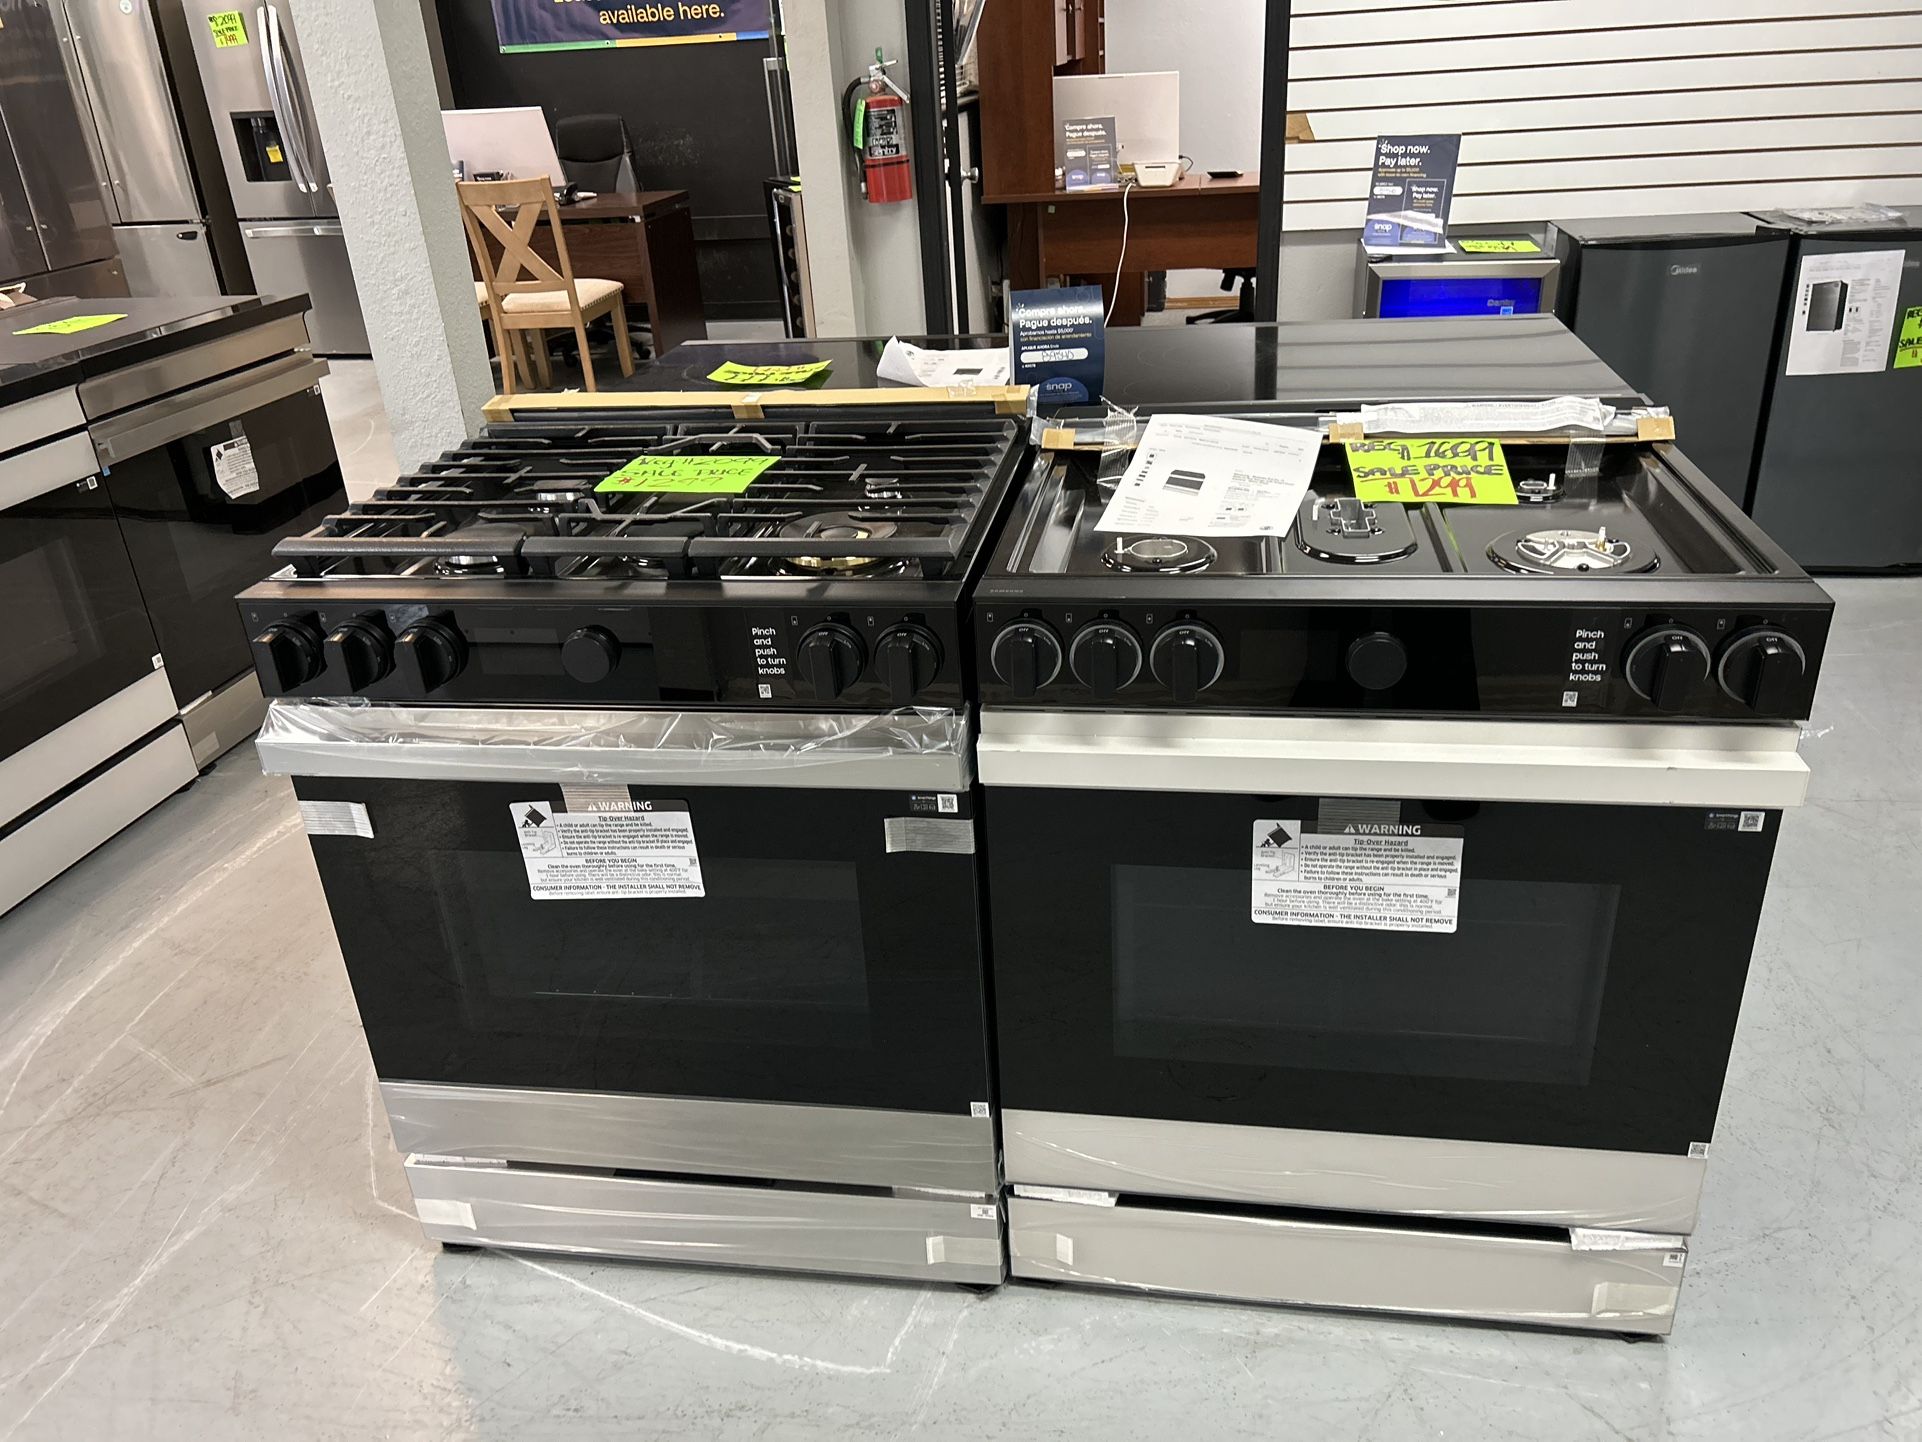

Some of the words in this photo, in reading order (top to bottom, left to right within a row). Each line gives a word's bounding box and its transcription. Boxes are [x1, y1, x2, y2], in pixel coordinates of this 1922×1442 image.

[600, 4, 674, 24] available
[678, 2, 725, 19] here.
[1380, 144, 1406, 154] Shop
[1406, 144, 1430, 154] now.
[1378, 156, 1398, 168] Pay
[1398, 156, 1422, 166] later.
[1018, 307, 1056, 318] Compre
[1020, 319, 1048, 329] Pague
[1050, 316, 1092, 326] después.
[1046, 382, 1072, 392] snap
[1353, 464, 1420, 479] SALE
[1424, 464, 1504, 477] PRICE
[752, 627, 776, 636] Pinch
[1576, 629, 1604, 638] Pinch
[1574, 641, 1596, 649] and
[755, 648, 777, 657] push
[1572, 652, 1598, 662] push
[1572, 662, 1582, 670] to
[1585, 662, 1606, 671] turn
[1570, 673, 1601, 682] knobs
[598, 801, 652, 810] WARNING
[1358, 824, 1421, 835] WARNING
[1290, 911, 1334, 919] INFORMATION
[1354, 914, 1387, 922] INSTALLER
